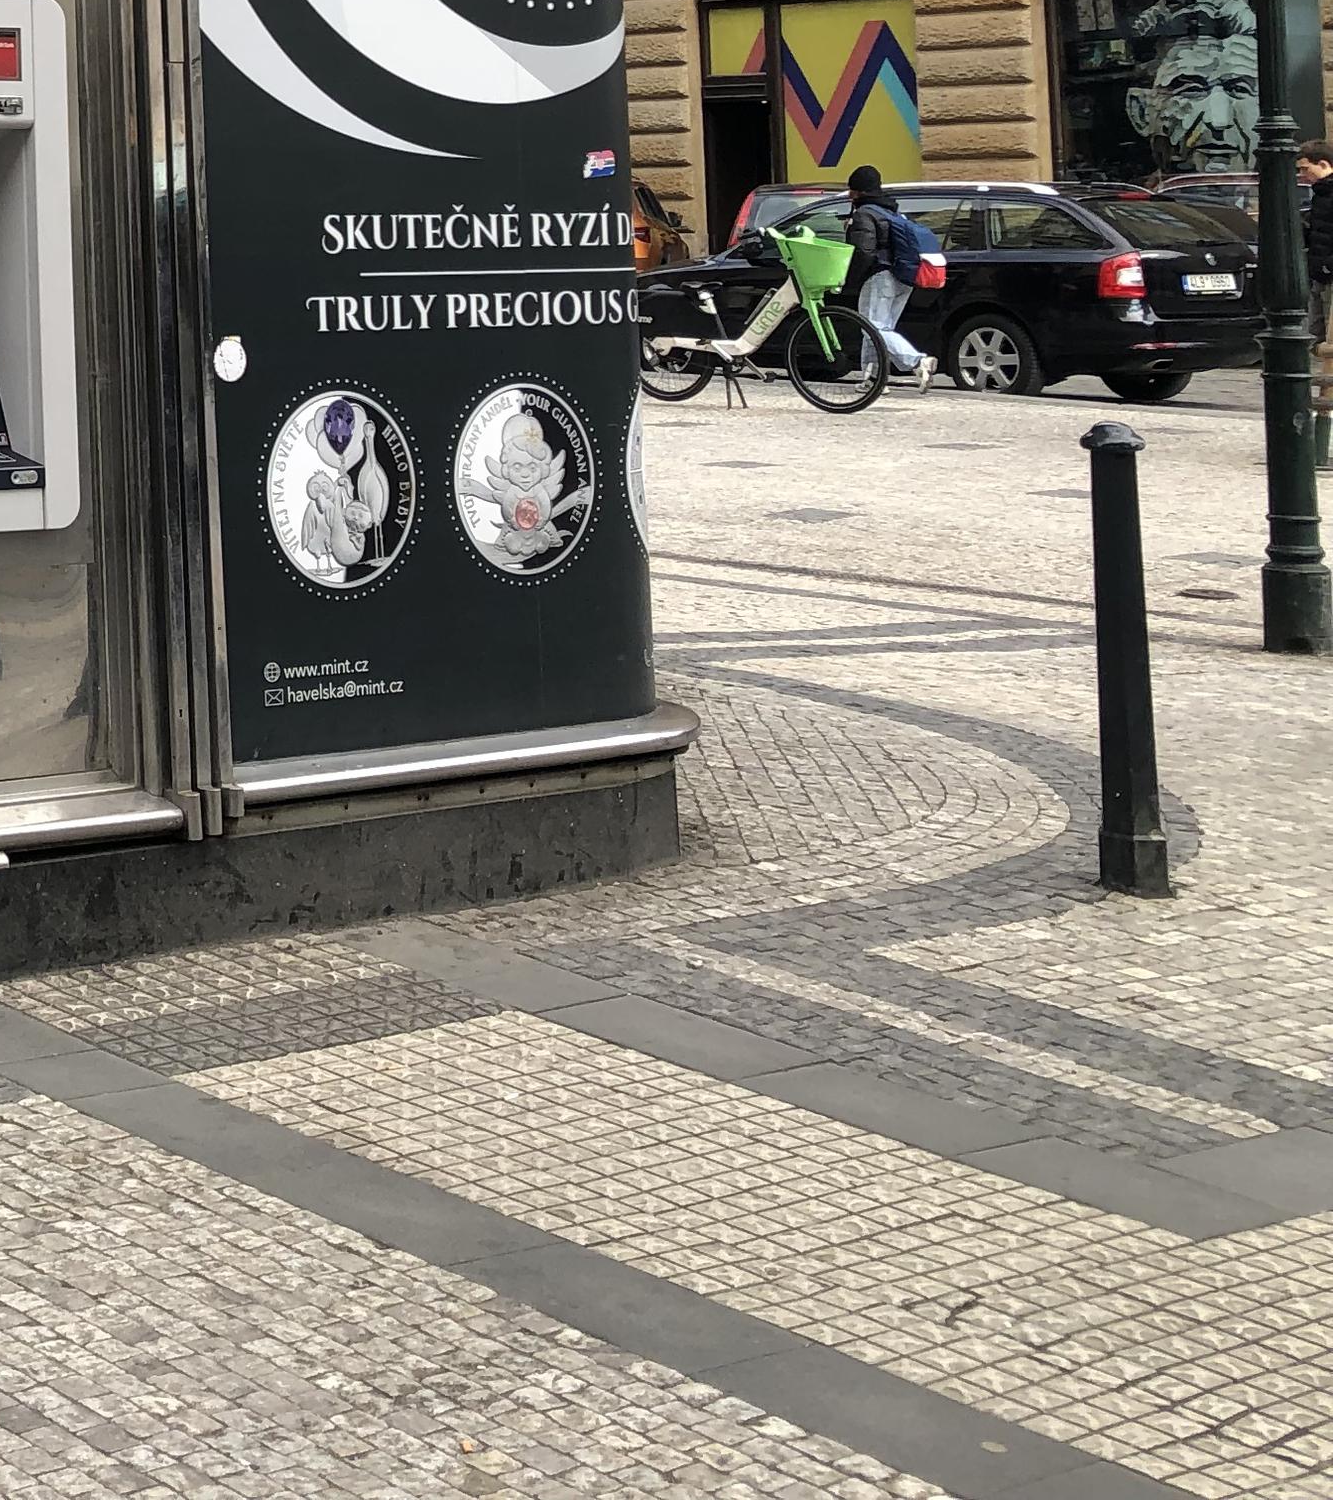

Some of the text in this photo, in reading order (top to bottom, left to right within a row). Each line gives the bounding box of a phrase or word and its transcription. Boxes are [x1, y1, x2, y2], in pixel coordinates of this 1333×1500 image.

[322, 203, 522, 254] SKUTEČNĚ
[531, 202, 611, 248] RYZÍ
[306, 294, 437, 332] TRULY
[445, 289, 622, 330] PRECIOUS
[517, 393, 552, 416] YOUR
[551, 407, 588, 474] GUARDIAN
[394, 480, 411, 530] BABY
[284, 658, 369, 679] www.mint.cz
[287, 680, 404, 703] havelska@mint.cz
